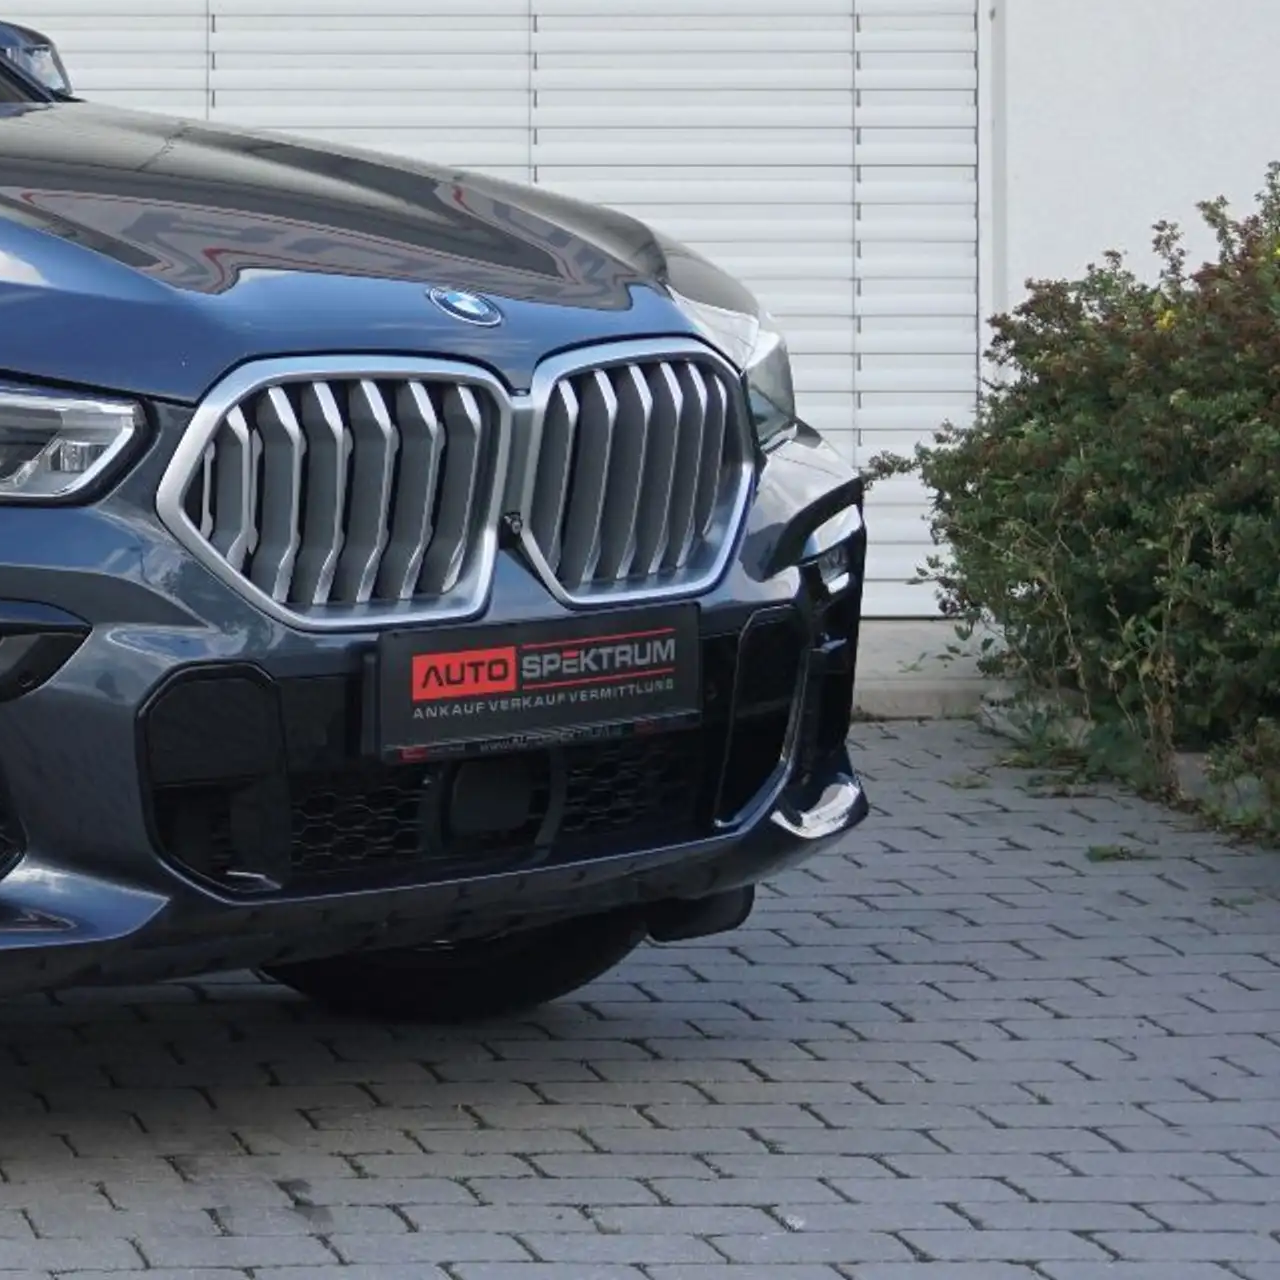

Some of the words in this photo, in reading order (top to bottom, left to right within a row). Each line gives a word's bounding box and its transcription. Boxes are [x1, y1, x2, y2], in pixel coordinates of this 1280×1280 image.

[421, 658, 509, 689] AUTO
[522, 638, 676, 679] SPEKTRUM
[413, 701, 486, 719] ANKAUF
[488, 694, 565, 713] VERKAUF
[568, 678, 674, 704] VERMITTLUNG
